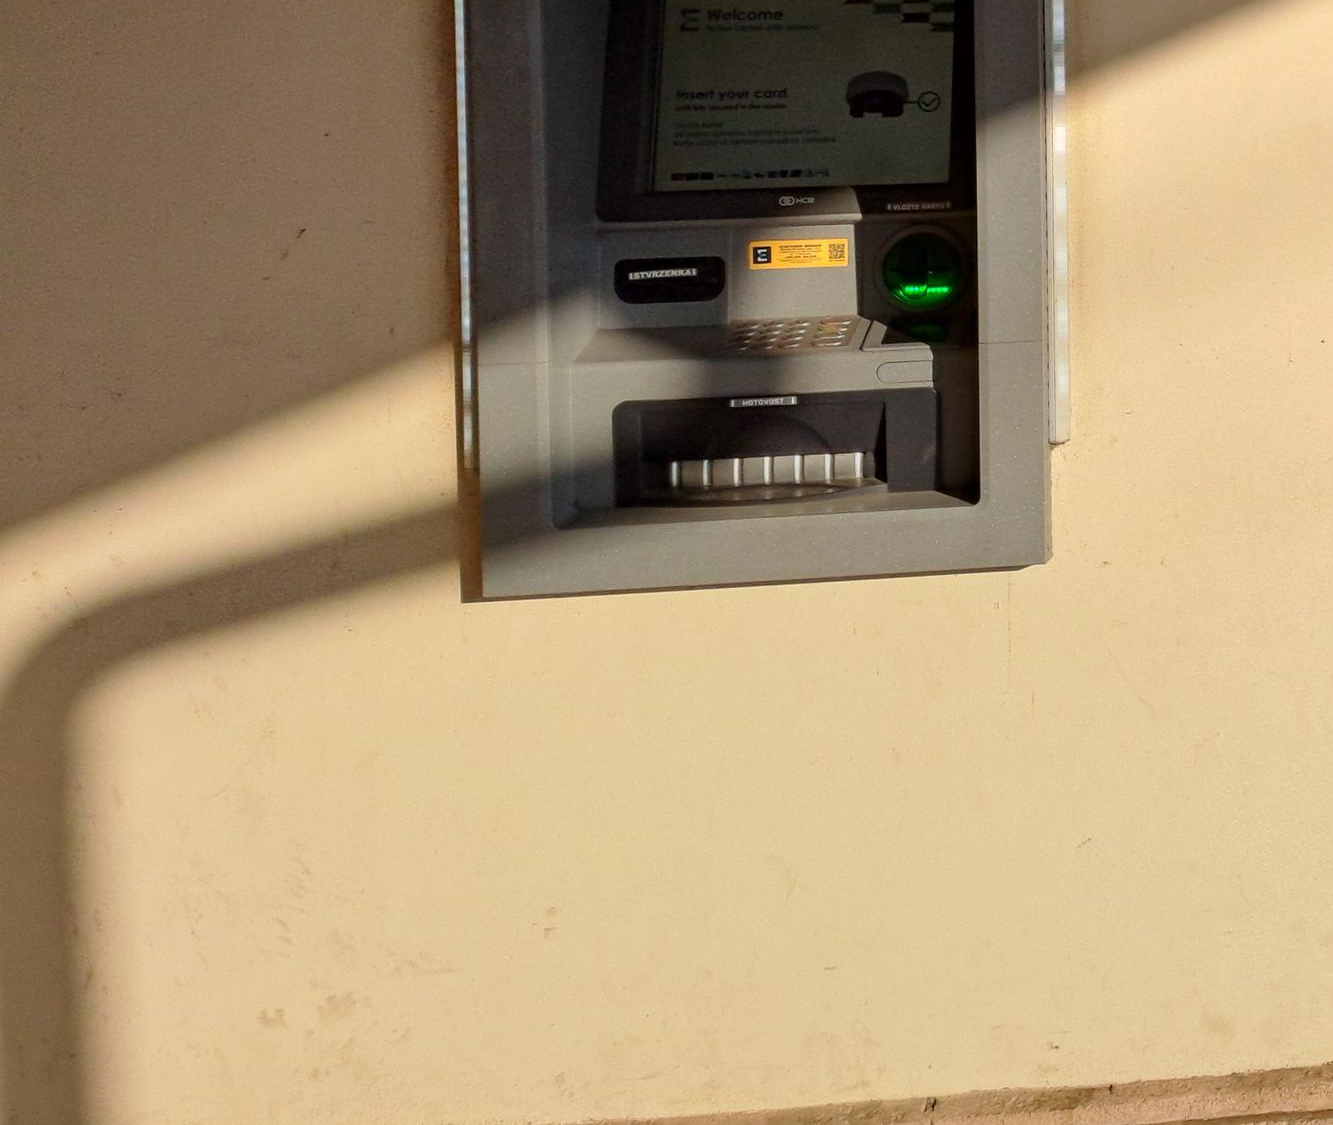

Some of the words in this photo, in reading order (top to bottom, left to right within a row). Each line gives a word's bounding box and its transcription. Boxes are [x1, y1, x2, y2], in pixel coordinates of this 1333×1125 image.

[706, 9, 785, 22] Welcome
[676, 88, 715, 101] Insert
[717, 90, 749, 102] your
[753, 87, 788, 100] card
[633, 268, 691, 280] STVRZENKA
[742, 397, 785, 407] HOTOVOST
